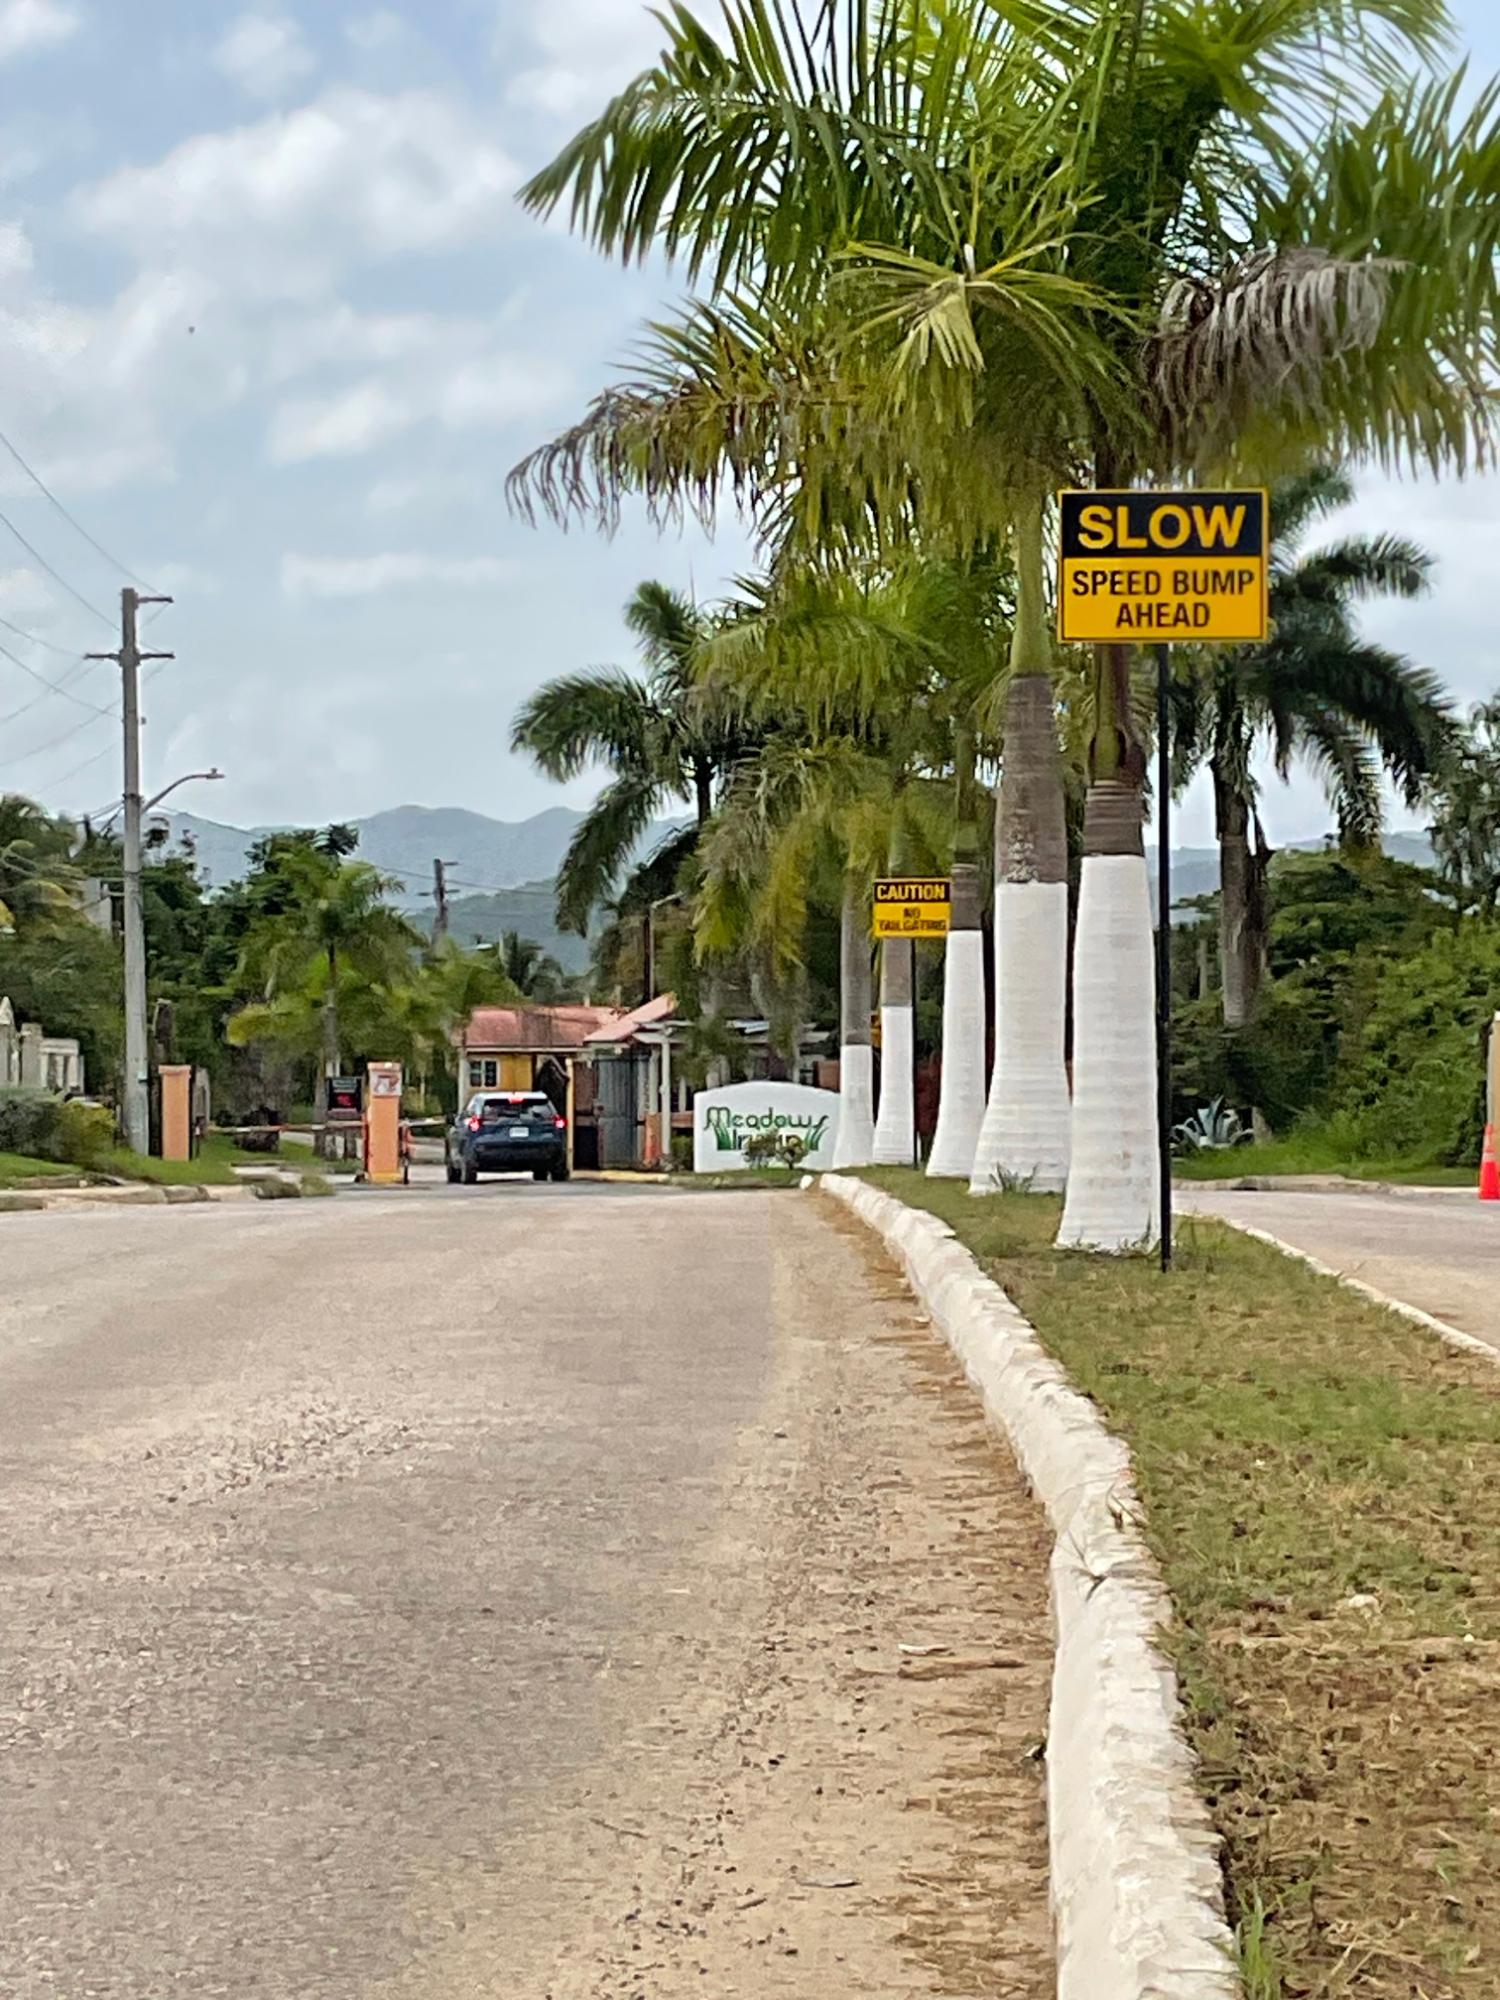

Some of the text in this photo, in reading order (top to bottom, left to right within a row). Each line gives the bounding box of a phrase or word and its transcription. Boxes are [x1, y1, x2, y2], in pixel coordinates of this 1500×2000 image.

[1078, 504, 1246, 549] SLOW
[1072, 570, 1254, 596] SPEED BUMP
[1116, 602, 1210, 628] AHEAD
[877, 884, 945, 900] CAUTION
[704, 1106, 829, 1130] Meadows
